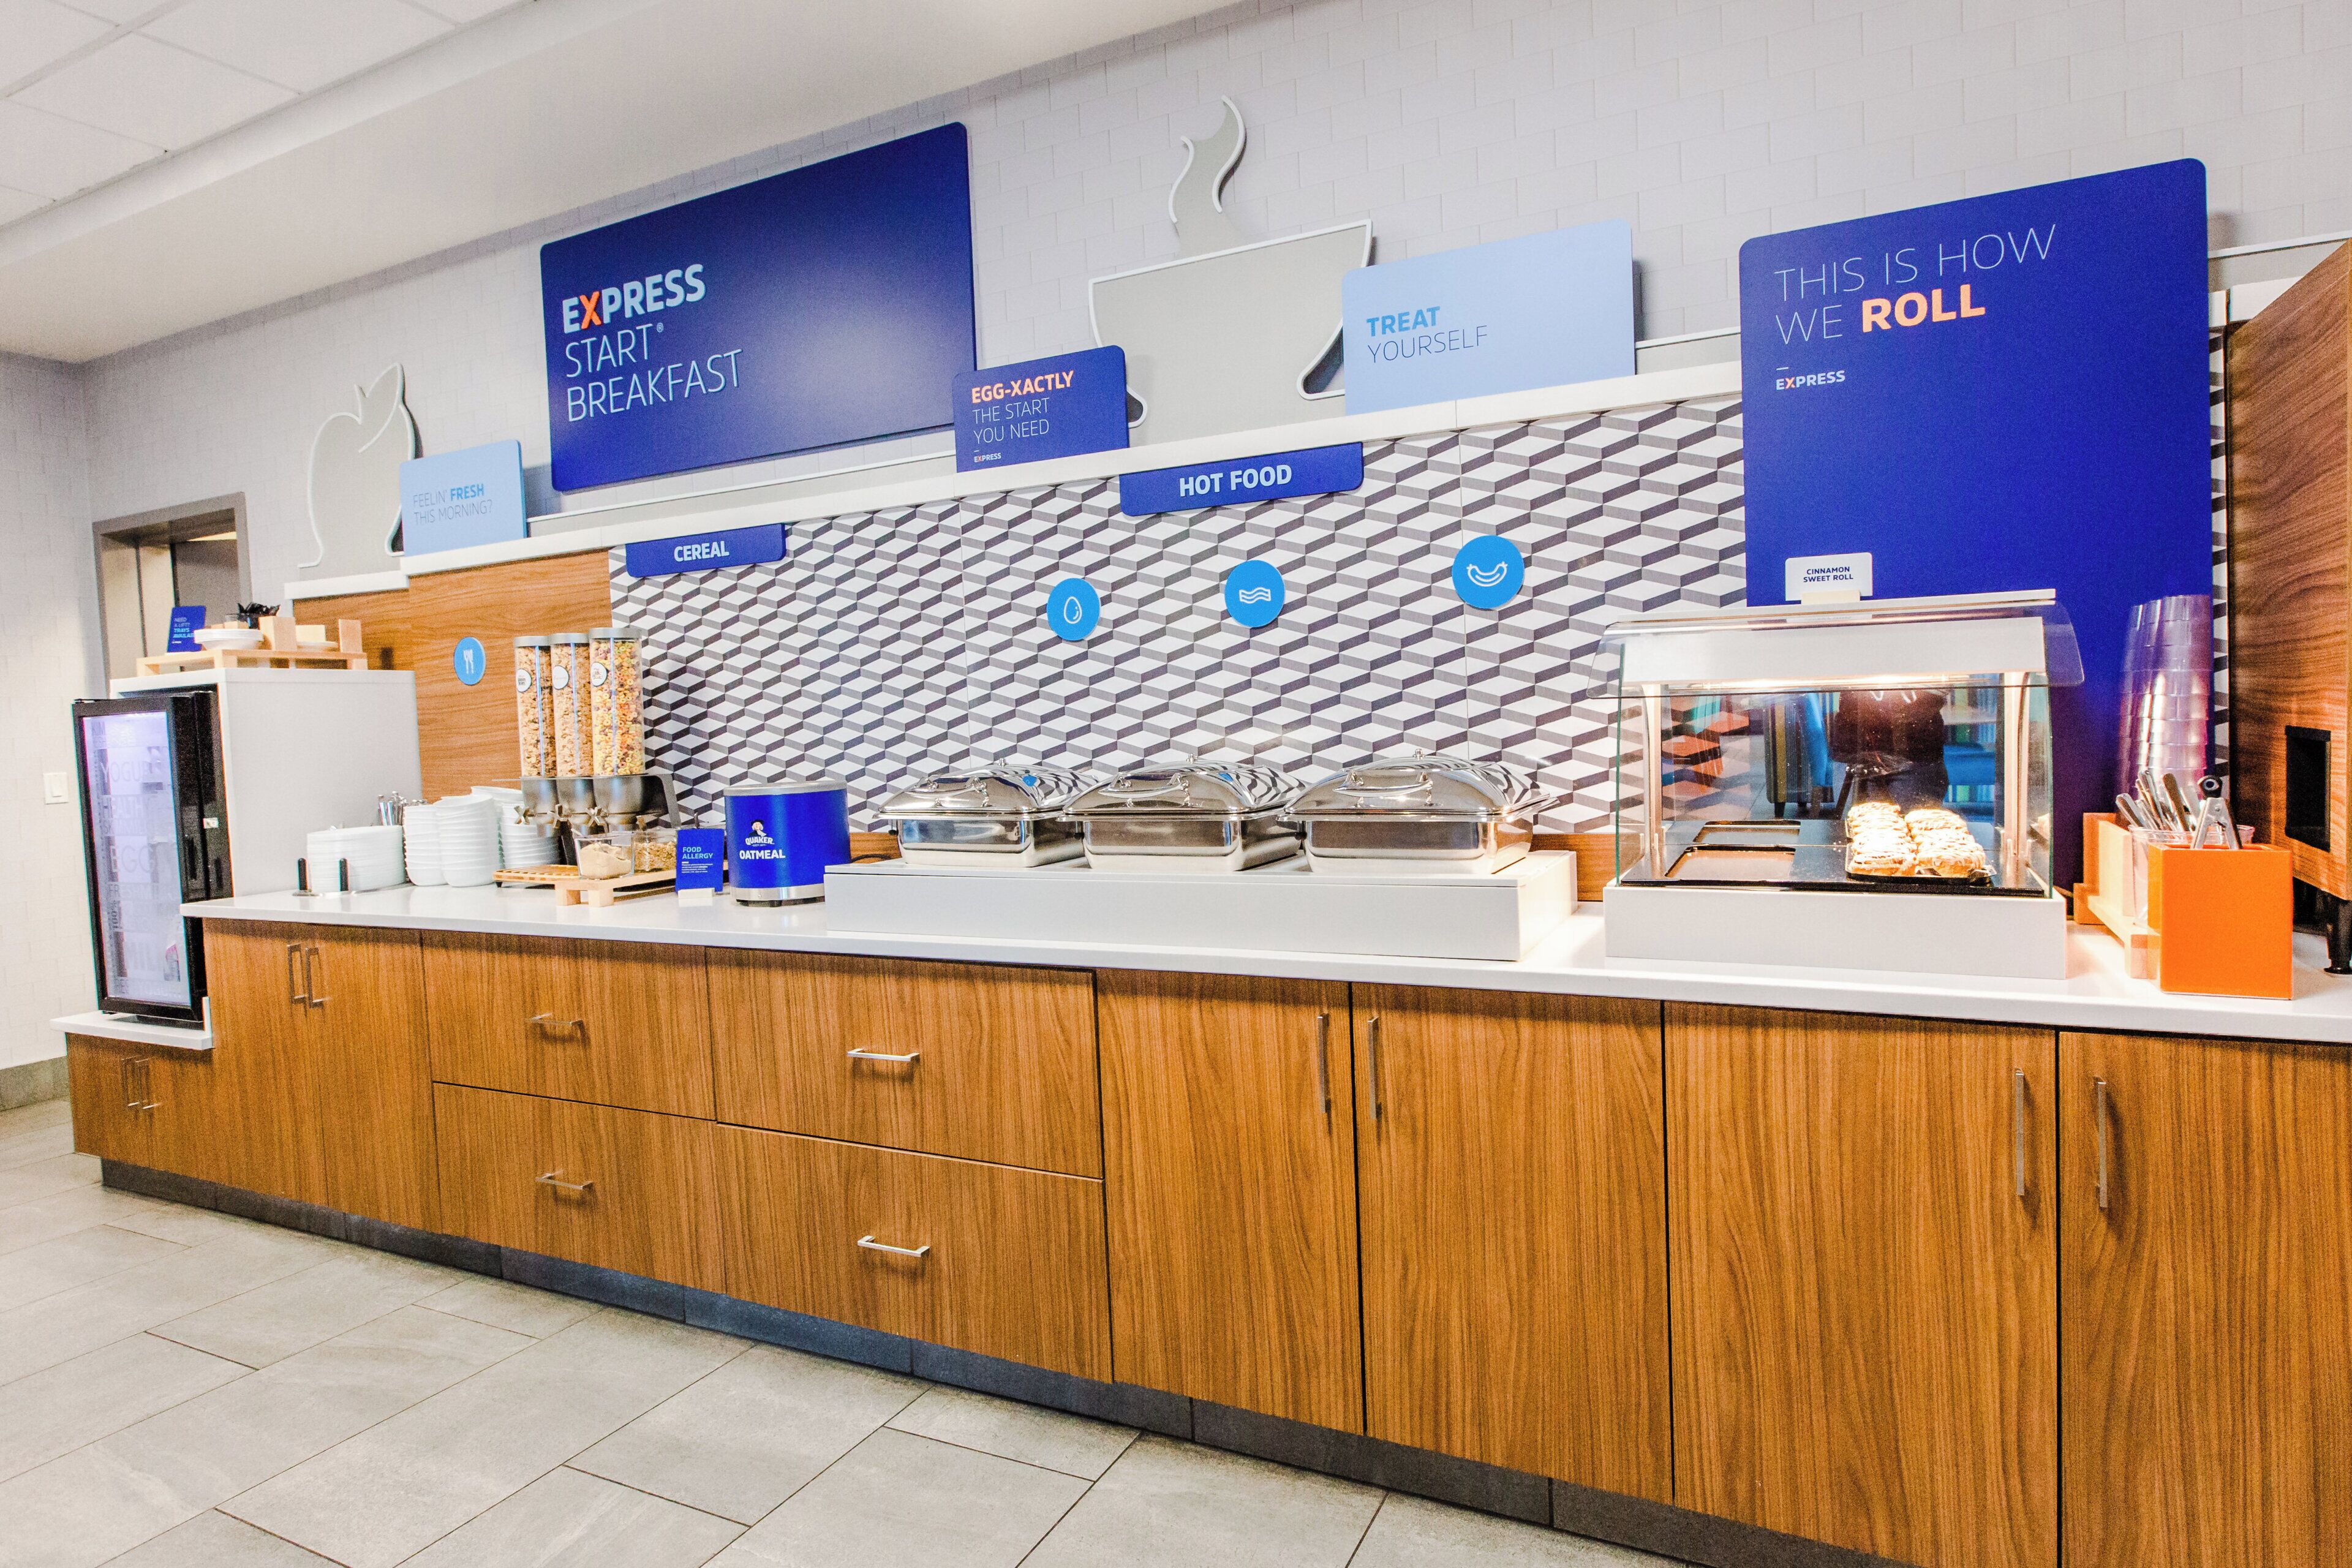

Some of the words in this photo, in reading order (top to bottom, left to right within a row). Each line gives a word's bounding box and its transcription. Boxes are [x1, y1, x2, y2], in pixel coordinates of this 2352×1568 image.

[1774, 257, 1865, 301] THIS
[1885, 248, 1918, 286] IS
[1939, 224, 2056, 277] HOW
[562, 263, 706, 334] EXPRESS
[1366, 306, 1441, 337] TREAT
[1776, 304, 1843, 345] WE
[1862, 284, 1986, 333] ROLL
[1367, 325, 1488, 363] YOURSELF
[567, 349, 742, 422] BREAKFAST
[971, 370, 1074, 404] EGG-XACTLY
[1776, 369, 1846, 391] EXPRESS
[972, 405, 1000, 424] THE
[1005, 397, 1050, 420] START
[973, 426, 1005, 444] YOU
[1010, 419, 1050, 439] NEED
[974, 453, 1002, 462] EXPRESS
[450, 483, 484, 502] FRESH
[1179, 472, 1224, 497] HOT
[1230, 464, 1292, 491] FOOD
[414, 509, 436, 526] THIS
[439, 499, 493, 520] MORNING?
[674, 540, 730, 562] CEREAL
[1806, 566, 1850, 575] CINNAMON
[739, 849, 786, 859] OATMEAL
[745, 837, 774, 845] QUAKER
